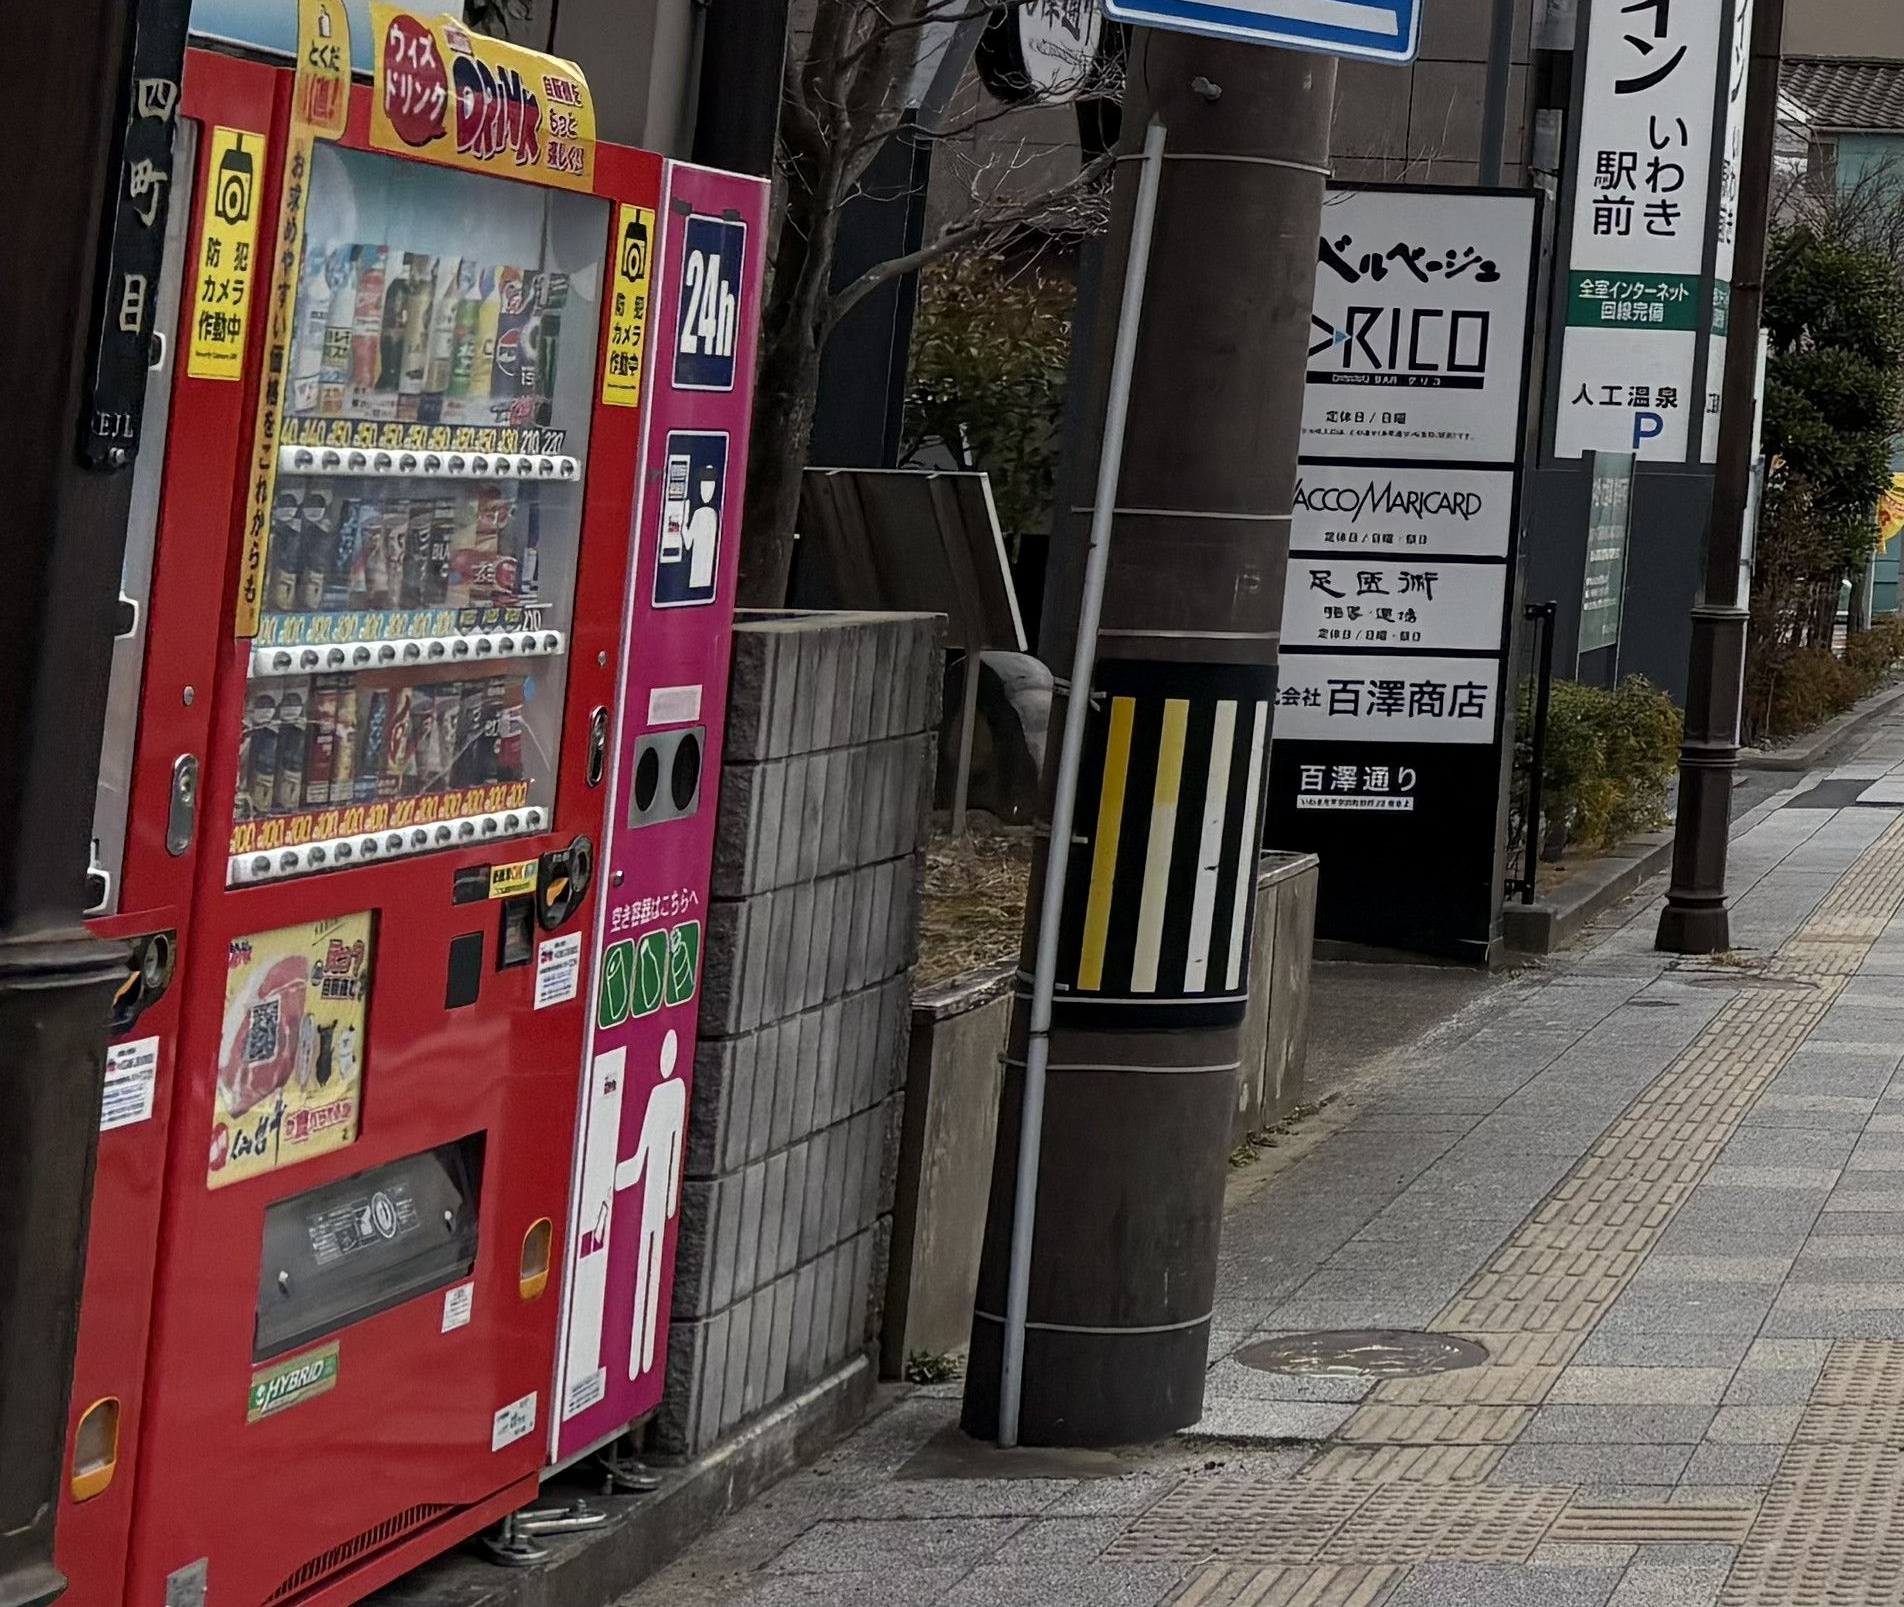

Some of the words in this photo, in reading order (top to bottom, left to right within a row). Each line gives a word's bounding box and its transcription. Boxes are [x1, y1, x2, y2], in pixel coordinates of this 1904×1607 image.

[391, 32, 435, 69] ウィズ
[386, 72, 447, 120] ドリンク
[453, 56, 541, 166] DRINK
[1593, 150, 1638, 236] 駅前
[1643, 115, 1687, 238] いわき
[119, 78, 177, 335] 四町目
[206, 237, 249, 271] 防犯
[202, 275, 244, 305] カメラ
[680, 250, 736, 356] 24h
[1579, 279, 1689, 302] 全室インターネット
[199, 310, 241, 343] 作動中
[1601, 301, 1664, 323] 回線完備
[613, 325, 641, 347] カメラ
[1572, 383, 1678, 409] 人工温泉
[1632, 412, 1664, 449] P
[1275, 679, 1489, 719] 会社百澤商店
[1300, 765, 1416, 792] 百澤通り
[610, 888, 699, 932] 空き容器はこちらへ
[267, 1360, 324, 1396] HYBRID
